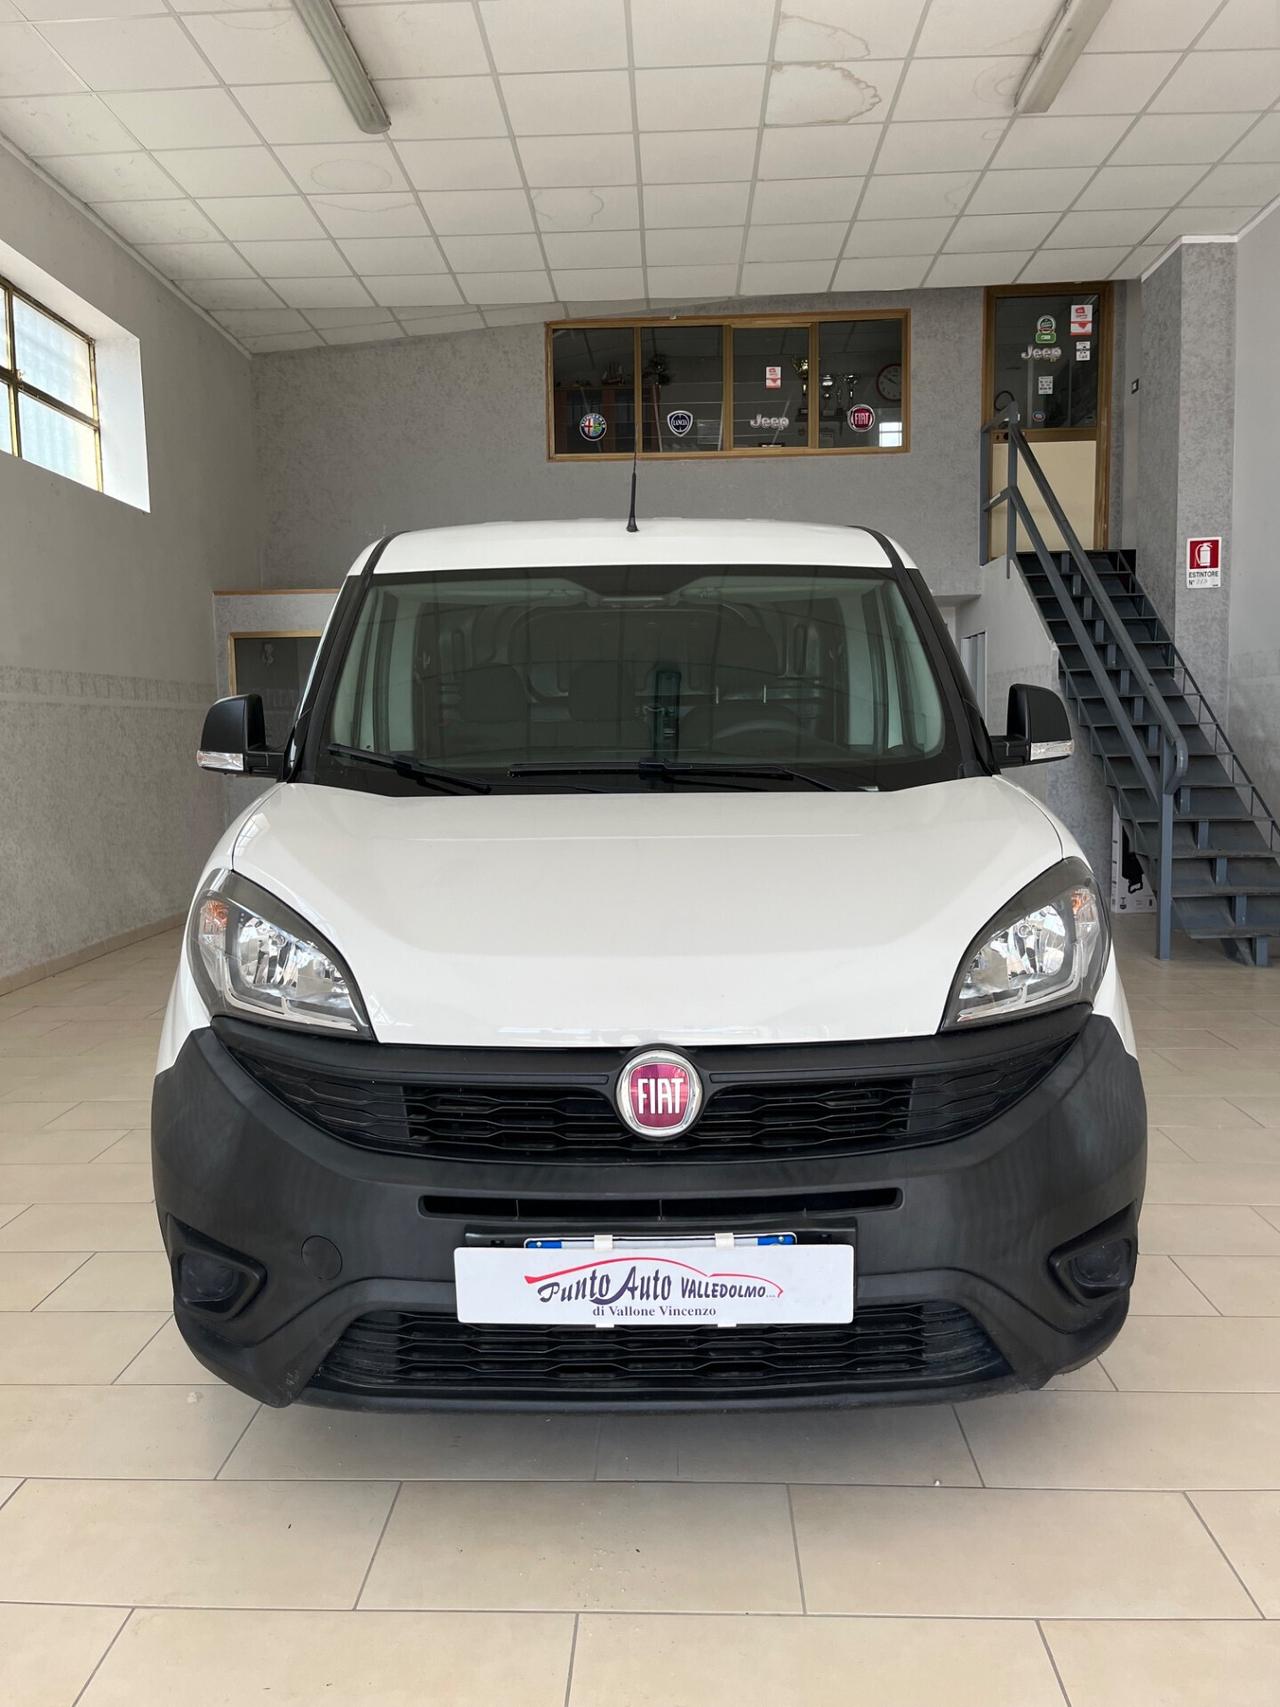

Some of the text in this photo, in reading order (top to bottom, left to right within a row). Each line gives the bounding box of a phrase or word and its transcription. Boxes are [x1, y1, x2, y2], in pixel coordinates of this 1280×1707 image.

[1021, 345, 1061, 362] Jeep
[750, 414, 789, 430] Jeep
[855, 412, 869, 424] FIAT
[1189, 570, 1219, 578] ESTINTORE
[637, 1078, 684, 1114] FIAT
[537, 1268, 611, 1303] Punto
[588, 1265, 672, 1306] Auto
[592, 1305, 717, 1316] di Vallone Vincenzo
